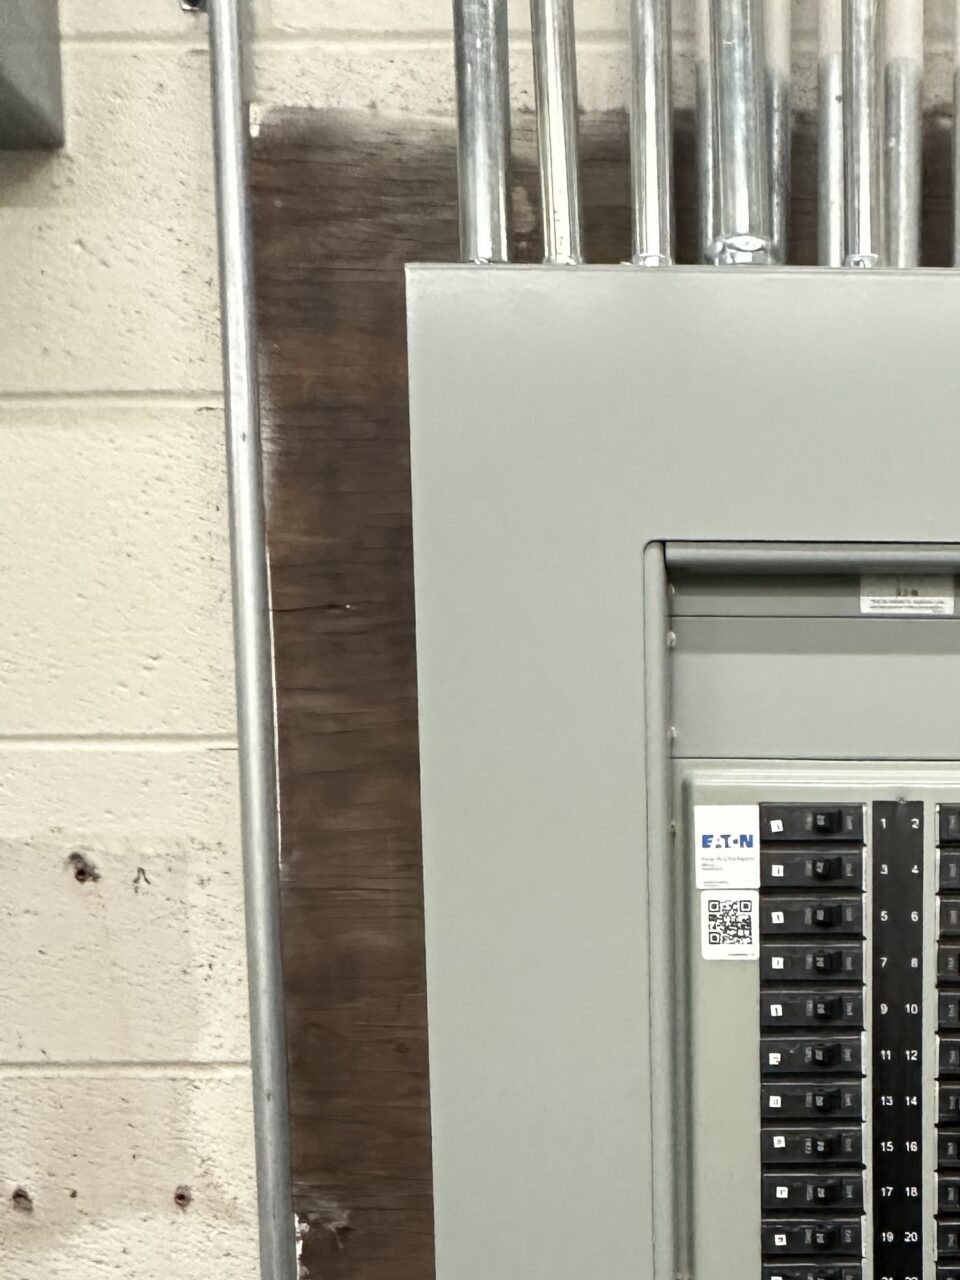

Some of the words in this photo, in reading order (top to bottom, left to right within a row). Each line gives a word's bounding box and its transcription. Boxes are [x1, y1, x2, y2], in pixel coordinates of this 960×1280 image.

[880, 817, 887, 830] 1
[910, 817, 920, 830] 2
[701, 834, 754, 849] EATON
[879, 863, 889, 875] 3
[879, 910, 889, 922] 5
[910, 910, 919, 922] 6
[879, 956, 888, 968] 7
[879, 1003, 889, 1015] 9
[904, 1003, 919, 1015] 10
[880, 1049, 892, 1061] 11
[905, 1049, 918, 1061] 12
[880, 1095, 894, 1107] 13
[905, 1095, 918, 1107] 14
[880, 1140, 894, 1152] 15
[905, 1140, 918, 1152] 16
[881, 1186, 894, 1197] 17
[905, 1186, 919, 1197] 18
[881, 1231, 894, 1243] 19
[903, 1231, 918, 1243] 20
